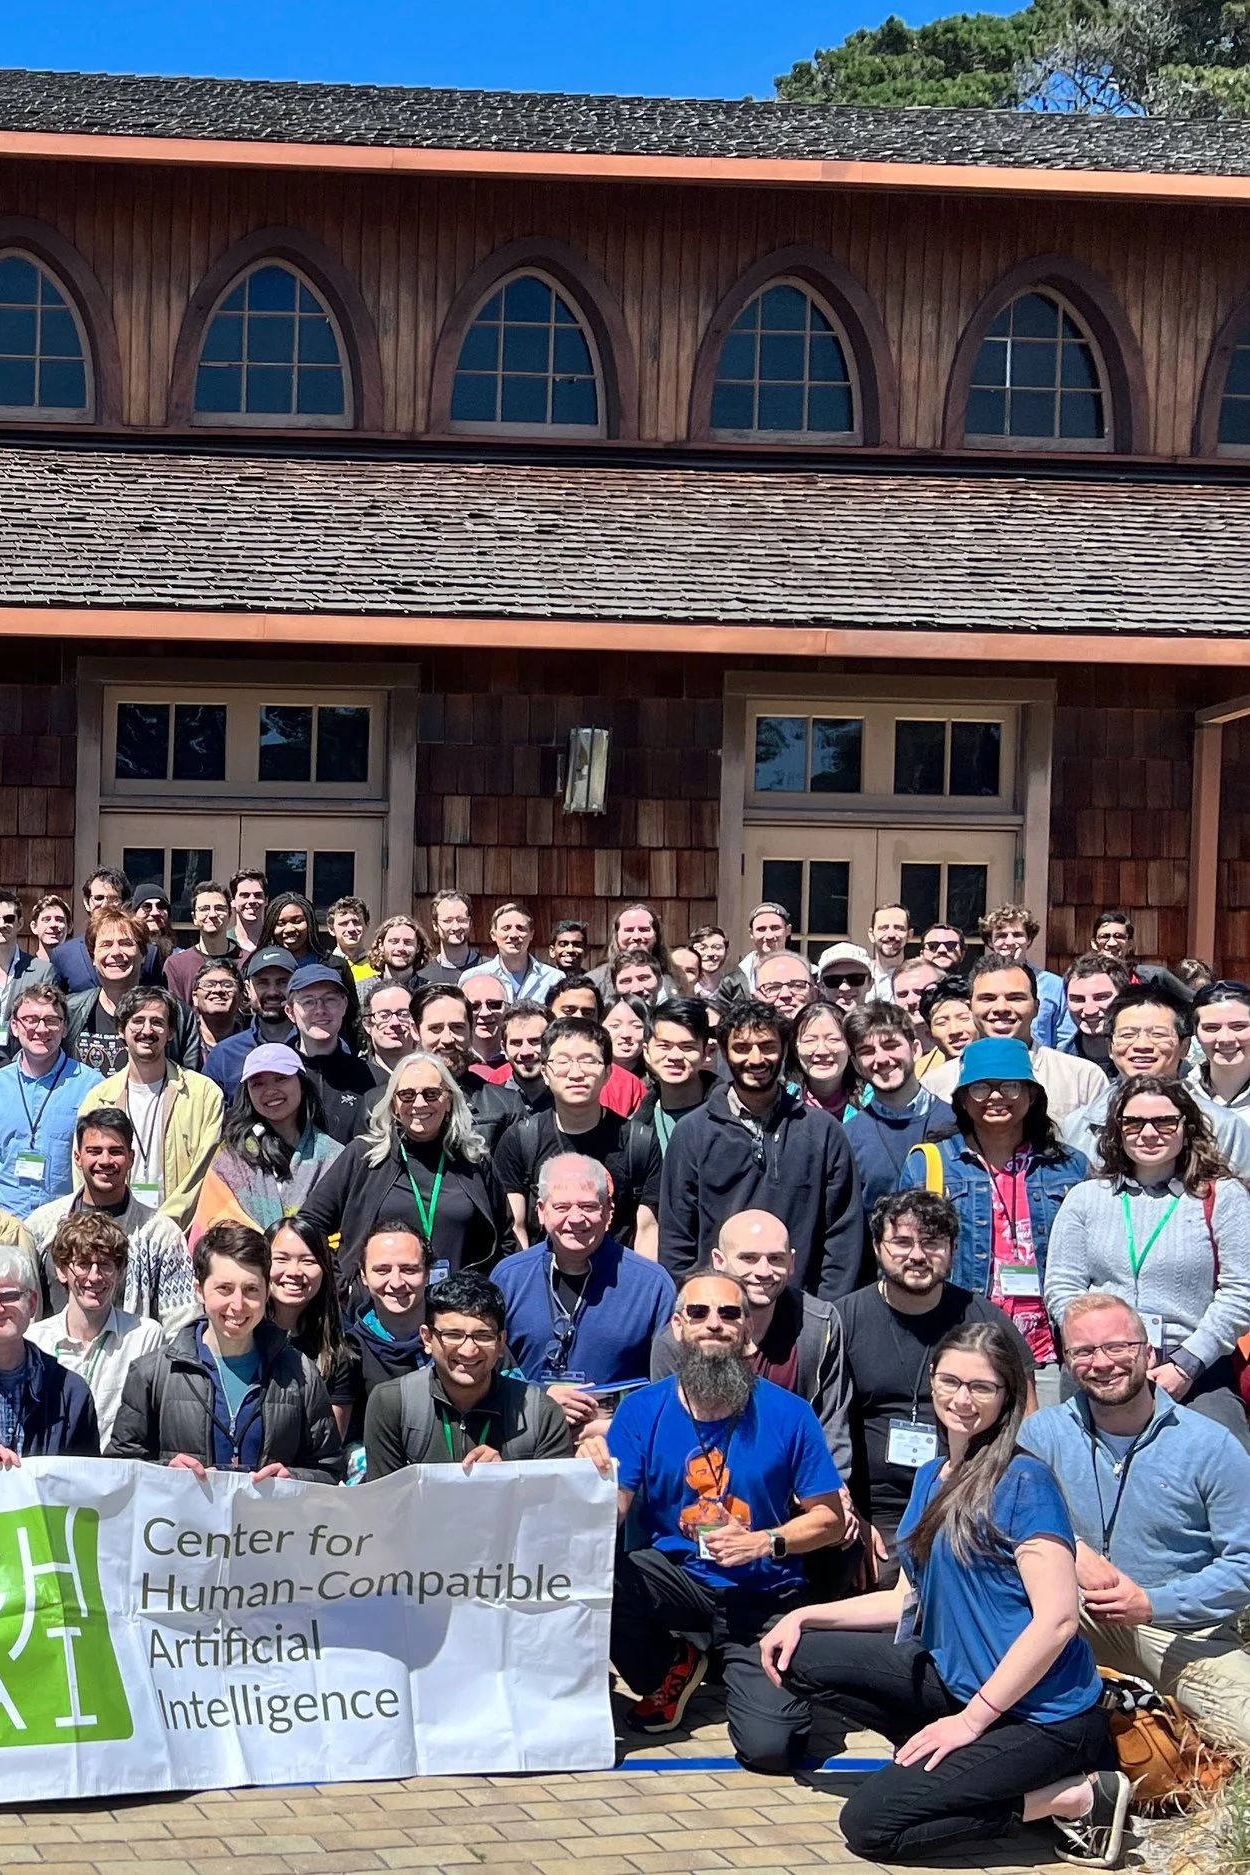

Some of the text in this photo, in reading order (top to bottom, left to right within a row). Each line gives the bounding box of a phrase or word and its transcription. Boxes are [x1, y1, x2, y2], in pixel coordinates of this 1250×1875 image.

[143, 1517, 374, 1559] Center for
[141, 1563, 572, 1612] Human-Compatible
[149, 1619, 322, 1669] Artificial
[158, 1684, 400, 1734] Intelligence
